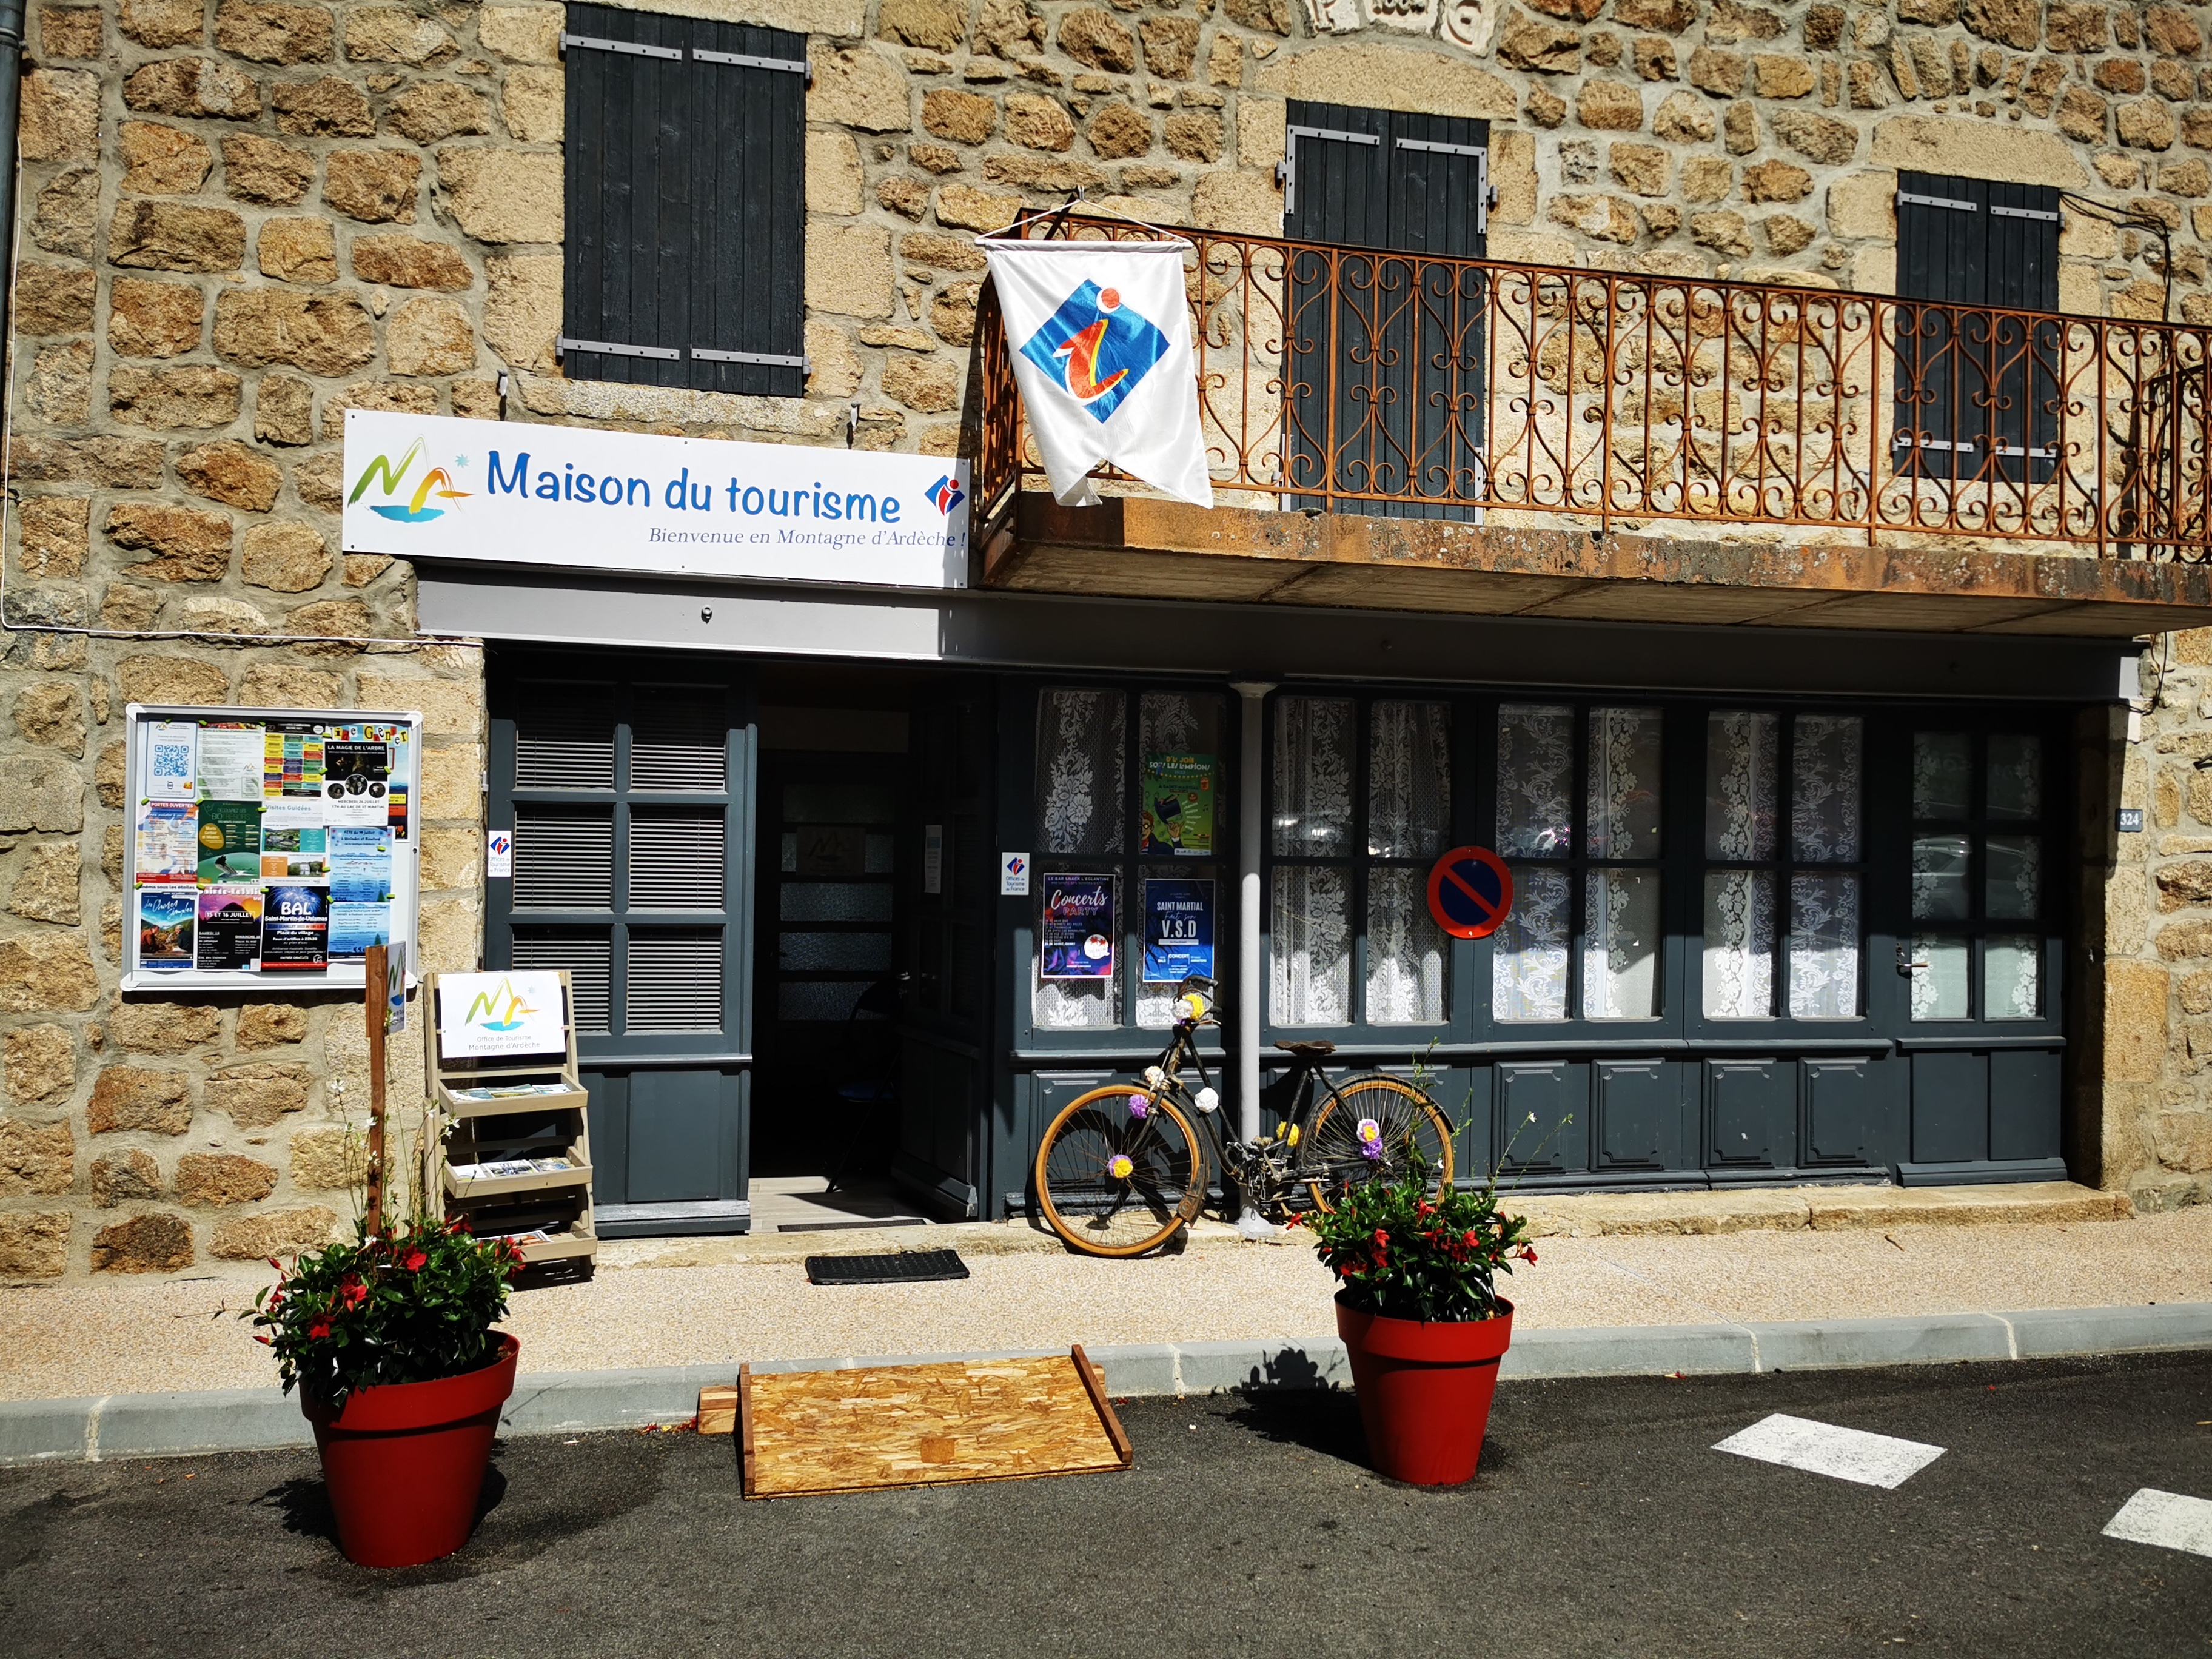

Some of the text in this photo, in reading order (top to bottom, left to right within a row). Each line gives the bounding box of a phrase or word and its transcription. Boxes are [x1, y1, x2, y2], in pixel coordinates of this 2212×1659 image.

[488, 451, 901, 523] Maison du tourisme
[648, 527, 966, 550] Bienvenue en Montagne d'Ardèche !
[2120, 813, 2139, 826] 324
[1051, 886, 1108, 910] Concerts
[281, 902, 312, 915] BAL
[1063, 907, 1098, 916] PARTY
[1156, 901, 1204, 911] SAINT MARTIAL
[1164, 911, 1182, 920] Fait
[1161, 920, 1196, 938] V.S.D
[469, 1042, 504, 1051] Montagne
